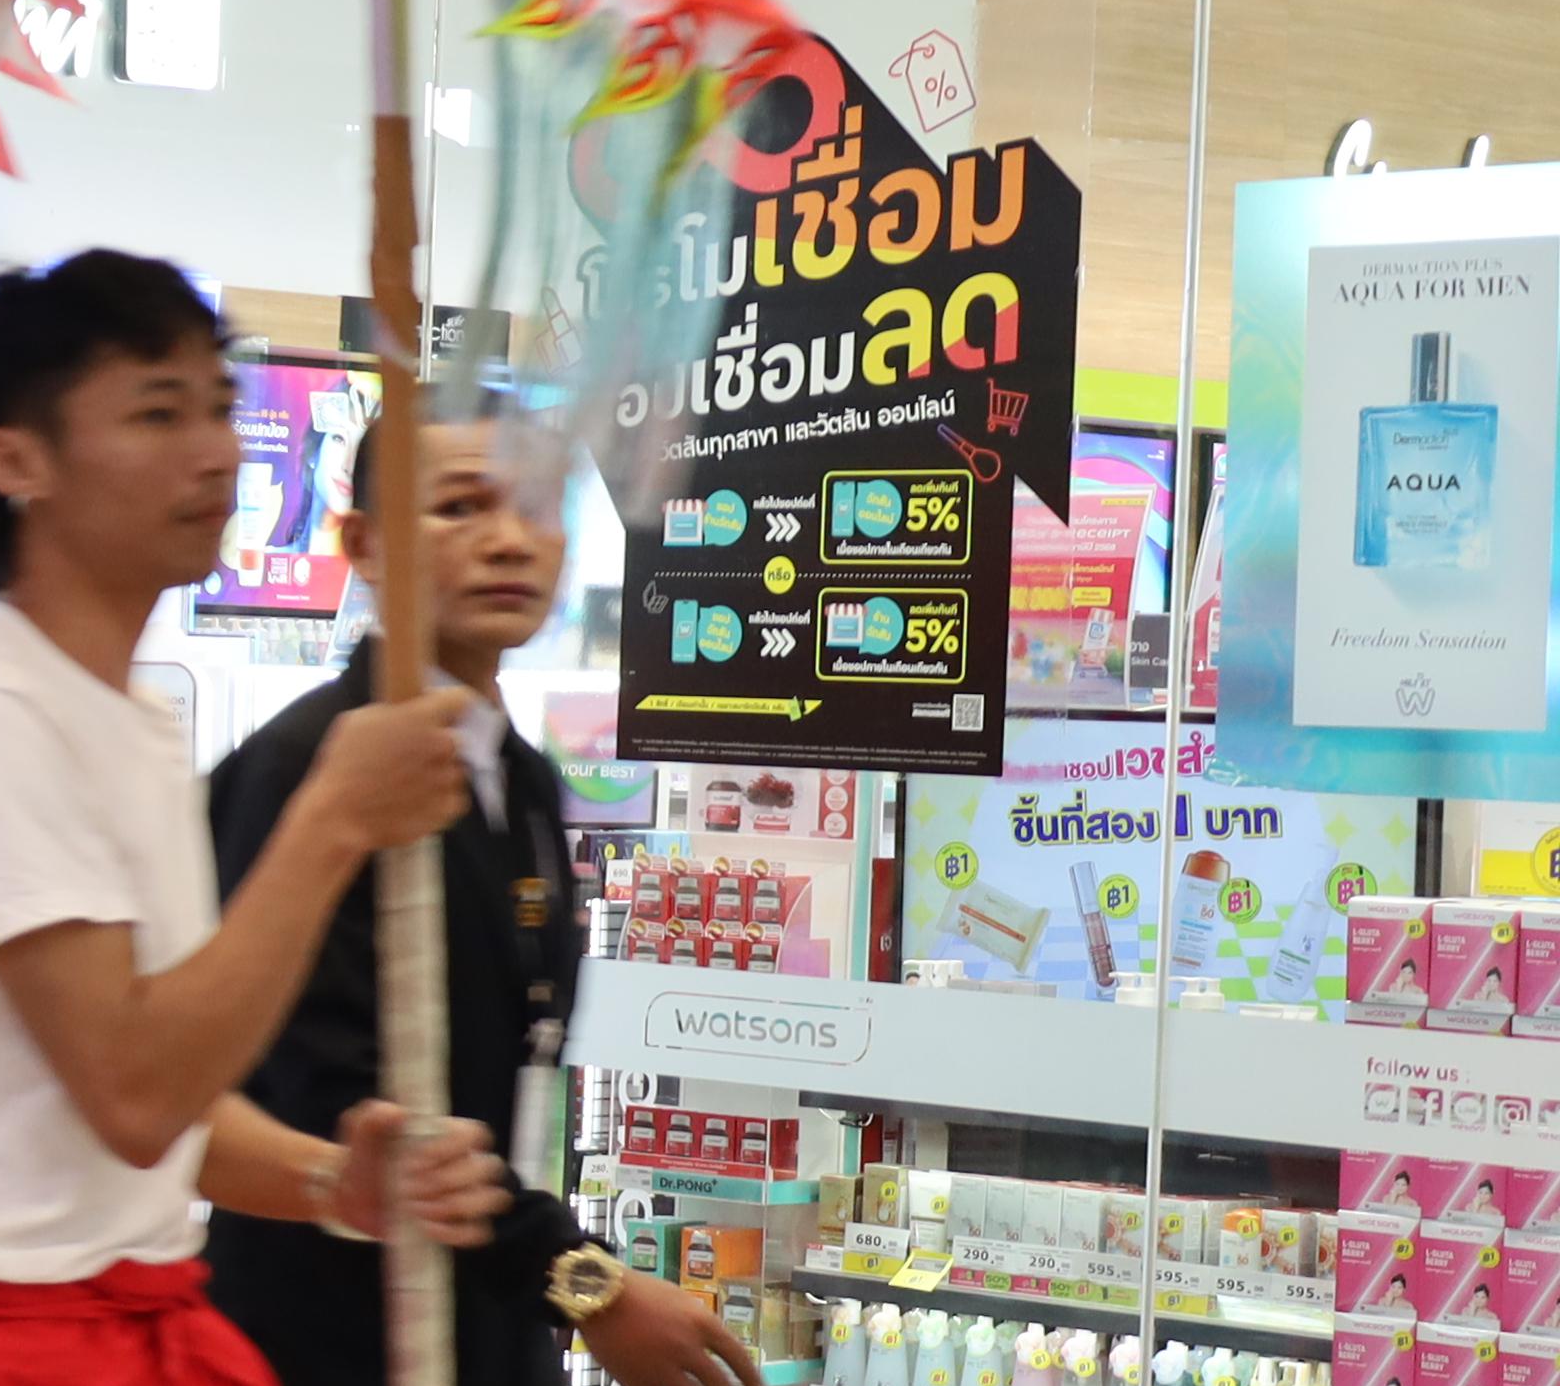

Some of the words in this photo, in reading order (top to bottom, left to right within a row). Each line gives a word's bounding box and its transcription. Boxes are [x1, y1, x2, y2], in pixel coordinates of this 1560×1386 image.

[1362, 259, 1462, 277] DERMACTION
[1334, 281, 1405, 307] AQUA
[1414, 278, 1465, 300] FOR
[1475, 274, 1531, 297] MEN
[877, 389, 956, 427] ออนไลน์
[1386, 473, 1461, 491] AQUA
[1329, 627, 1410, 649] Freedom
[1414, 628, 1508, 651] Sensation
[1011, 788, 1160, 845] ชิ้นที่สอง
[1204, 801, 1283, 841] บาท
[674, 1007, 838, 1048] watsons
[1366, 1056, 1430, 1080] follow
[1436, 1067, 1459, 1083] us
